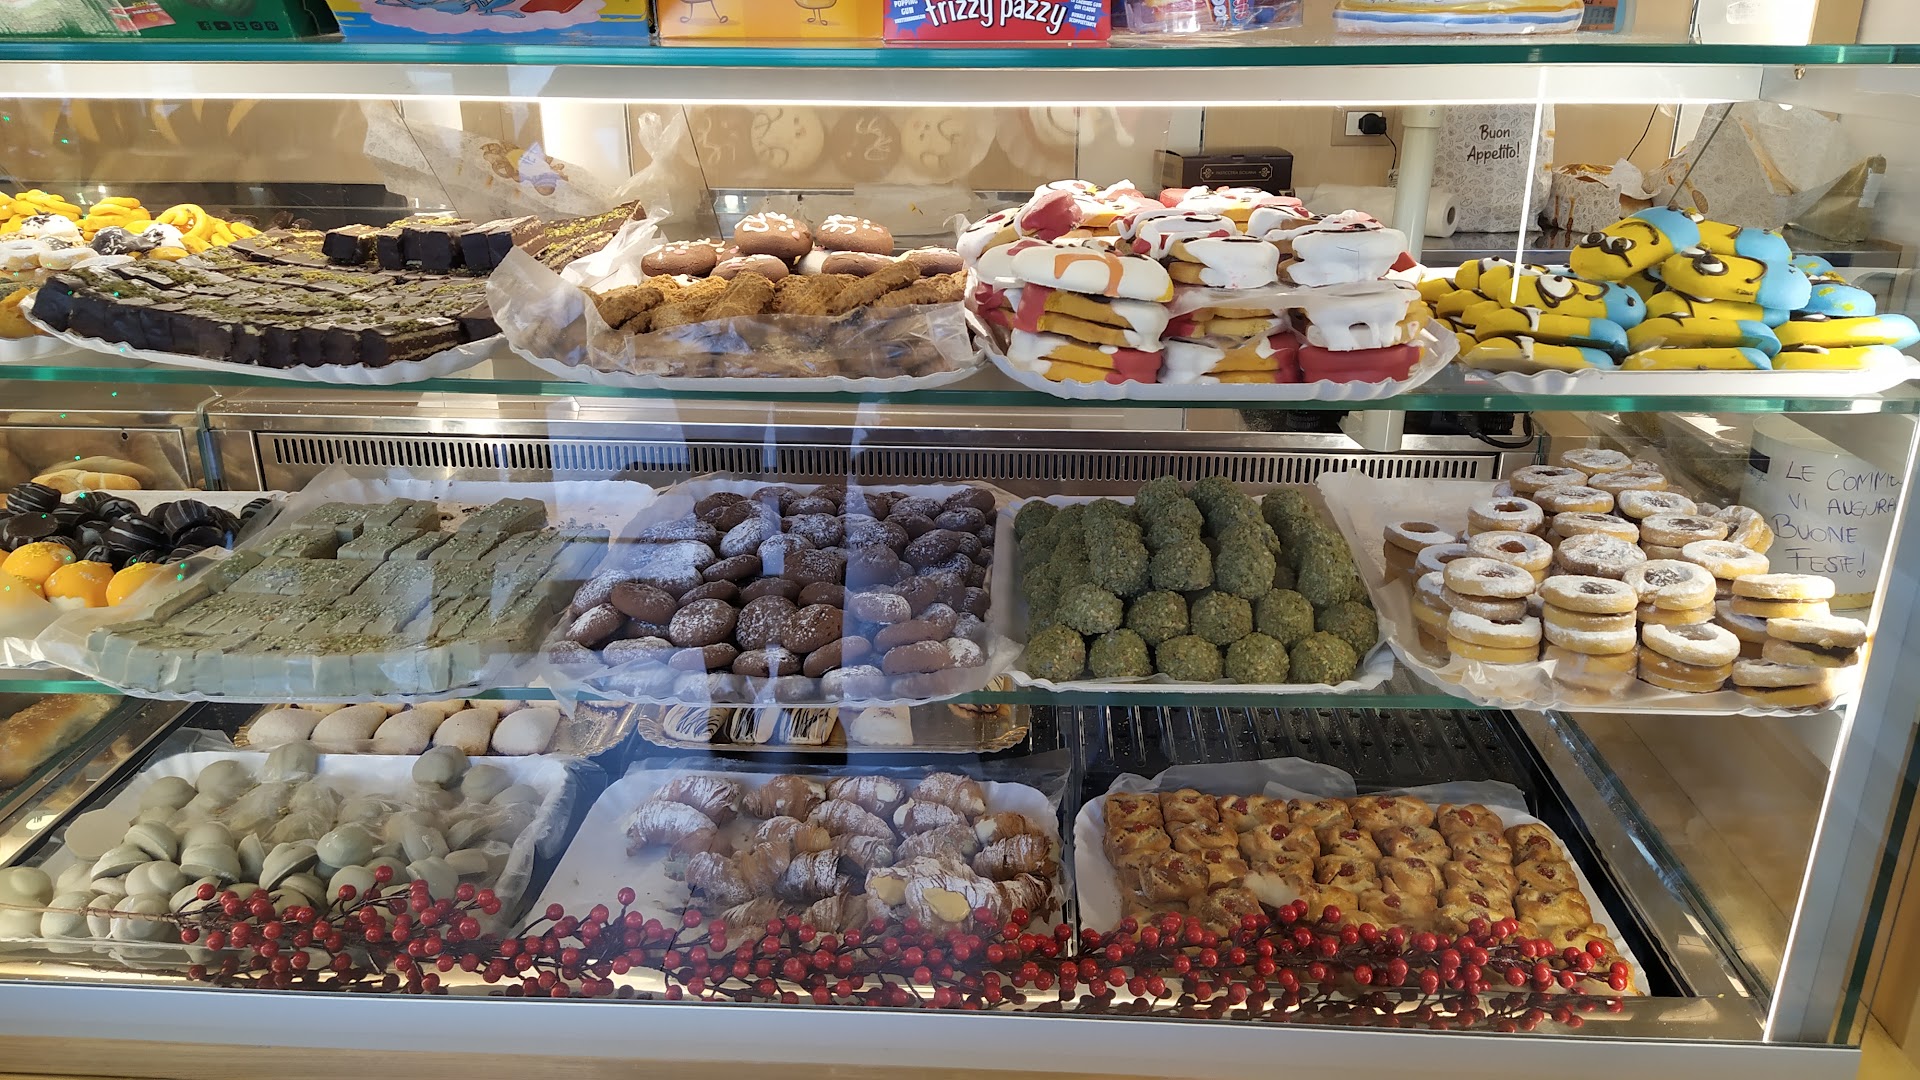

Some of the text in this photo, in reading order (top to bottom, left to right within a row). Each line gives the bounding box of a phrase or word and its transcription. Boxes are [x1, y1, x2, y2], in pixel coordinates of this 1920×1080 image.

[901, 7, 914, 16] GUM
[925, 0, 1067, 35] frizzy pazzy
[1479, 124, 1511, 141] Buon
[1467, 141, 1520, 165] Appetito!
[1785, 461, 1817, 483] LE
[1788, 492, 1808, 511] VI
[1771, 513, 1859, 543] BUONE
[1785, 547, 1865, 573] FESTE!
